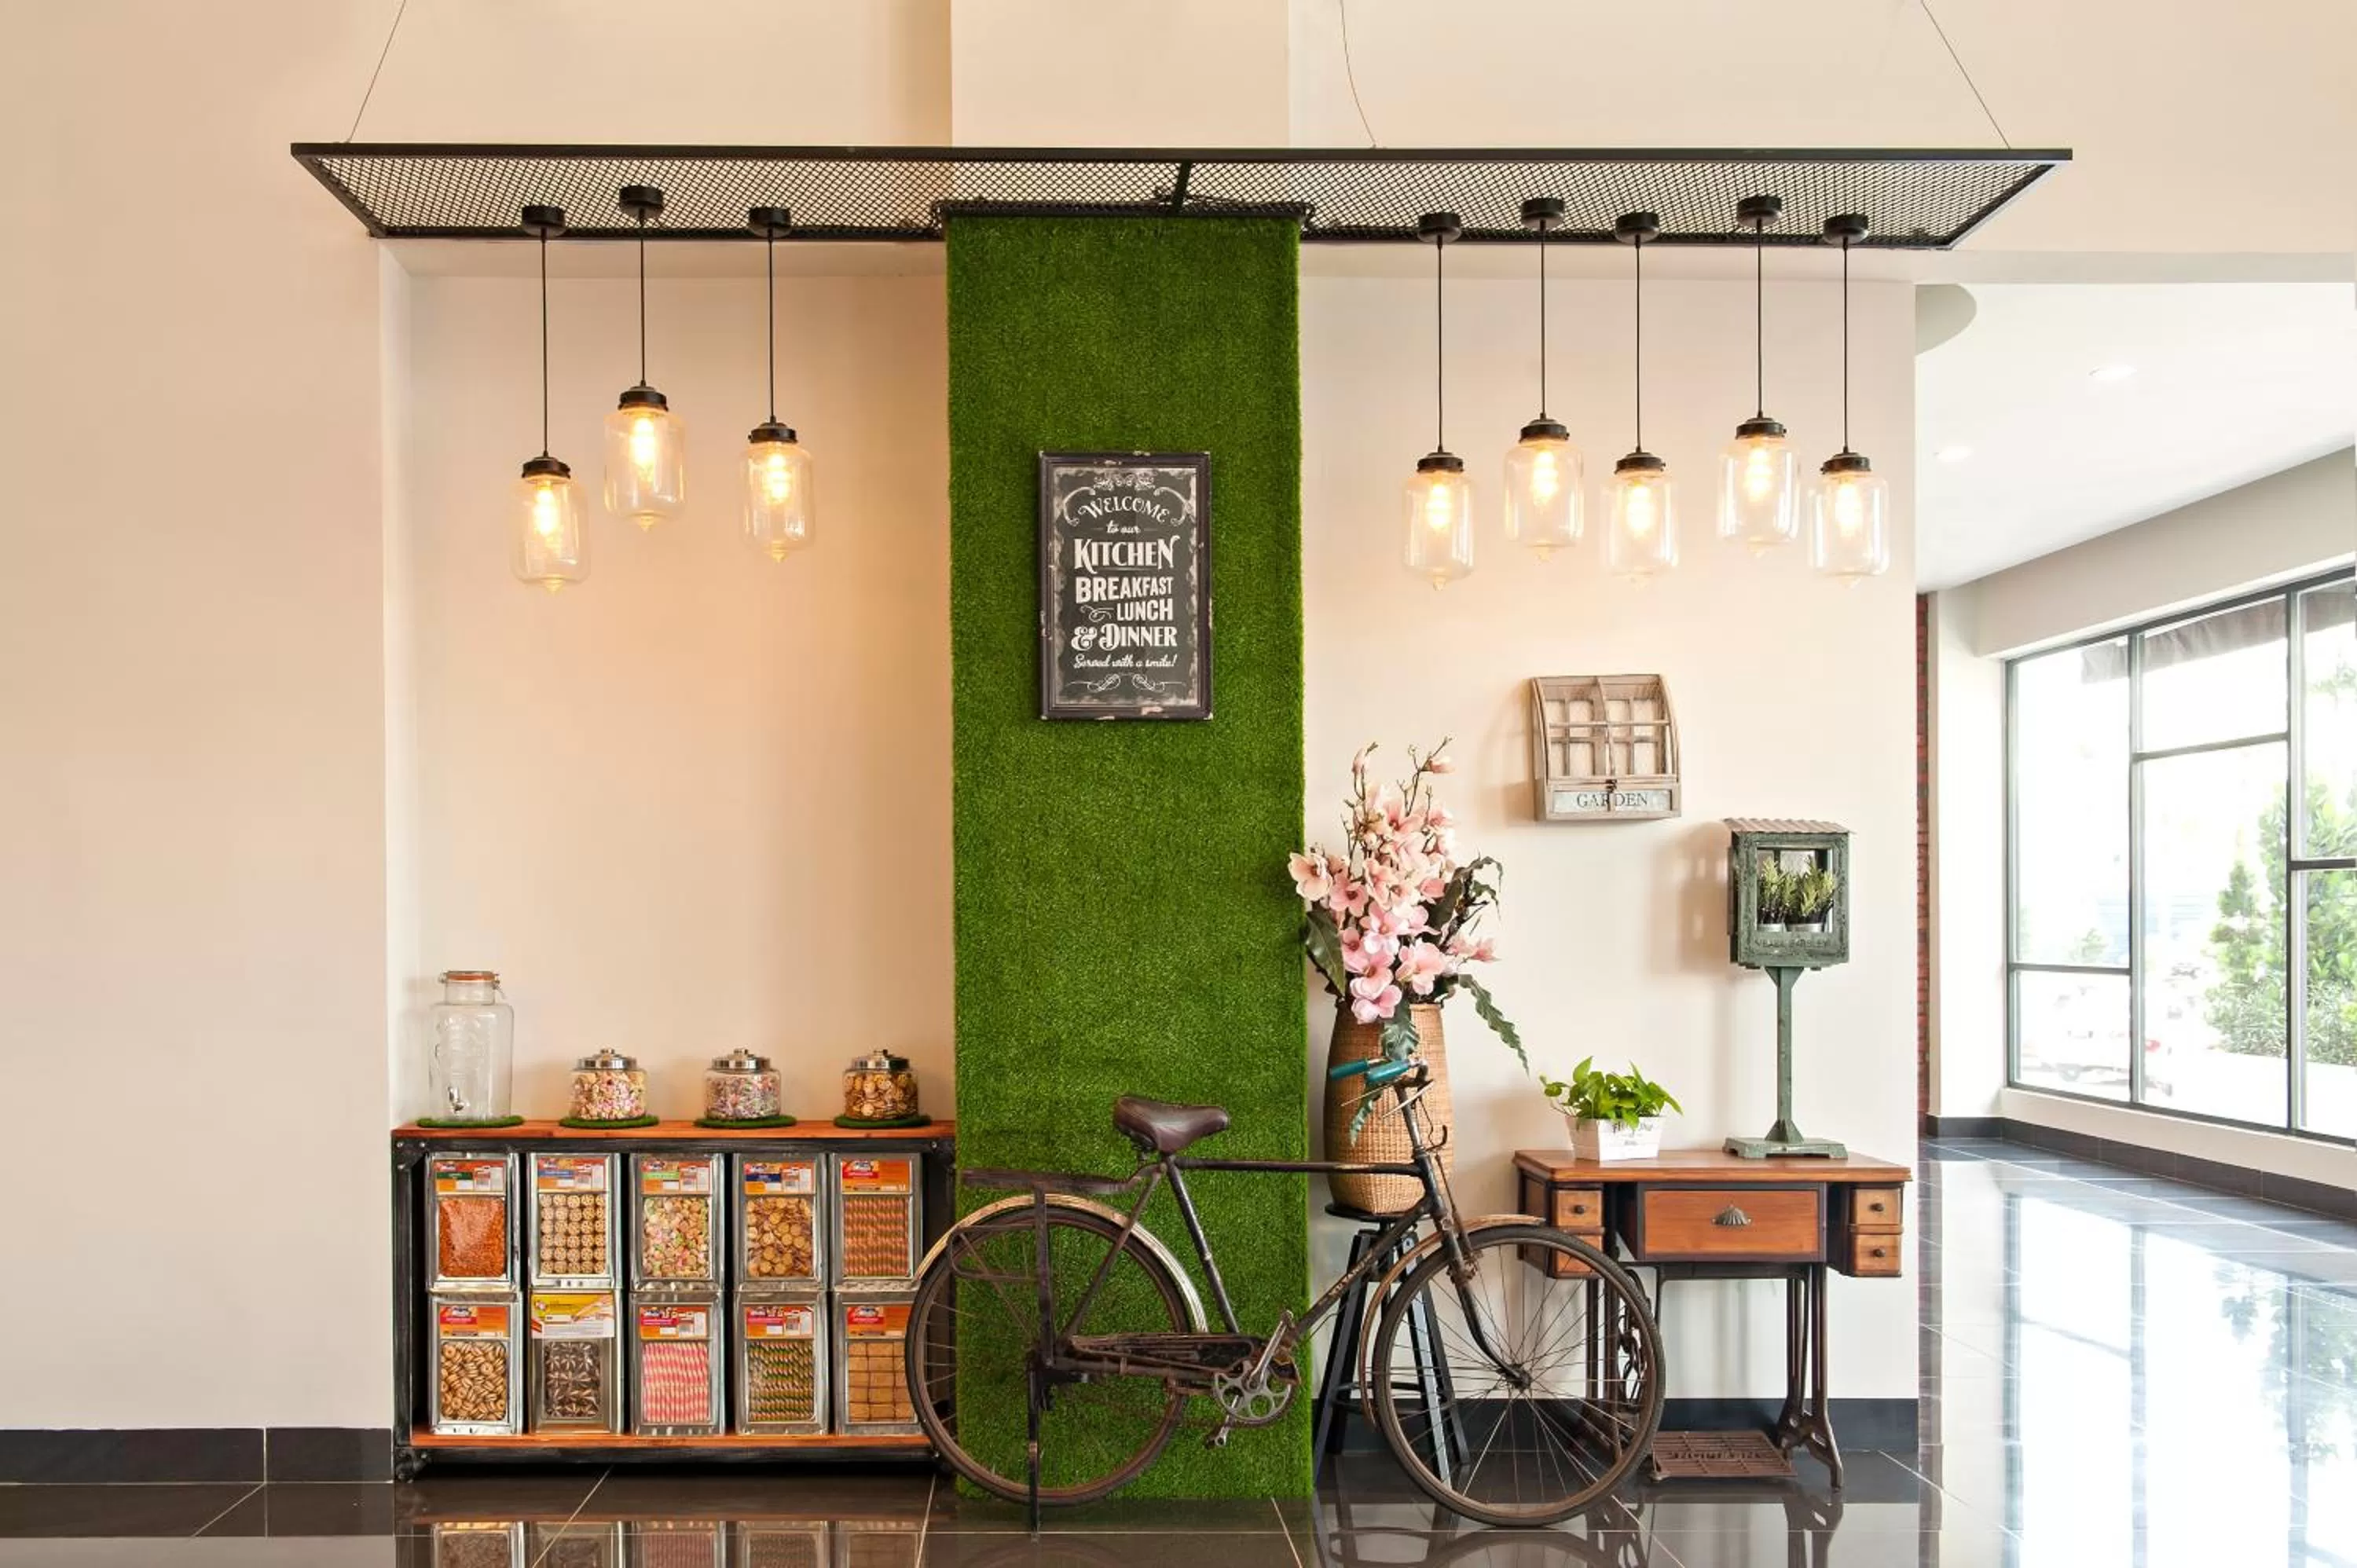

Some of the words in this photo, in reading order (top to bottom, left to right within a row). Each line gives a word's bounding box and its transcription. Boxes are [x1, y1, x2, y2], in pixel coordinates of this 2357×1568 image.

[1078, 495, 1170, 522] WELCOME
[1106, 519, 1120, 533] to
[1120, 525, 1142, 533] our
[1074, 535, 1180, 574] KITCHEN
[1076, 577, 1174, 603] BREAKFAST
[1116, 598, 1174, 621] LUNCH
[1071, 626, 1098, 651] &
[1098, 623, 1178, 651] DINNER
[1073, 654, 1111, 669] Served
[1112, 654, 1134, 668] with
[1145, 654, 1178, 668] smile!
[1577, 793, 1648, 808] GARDEN
